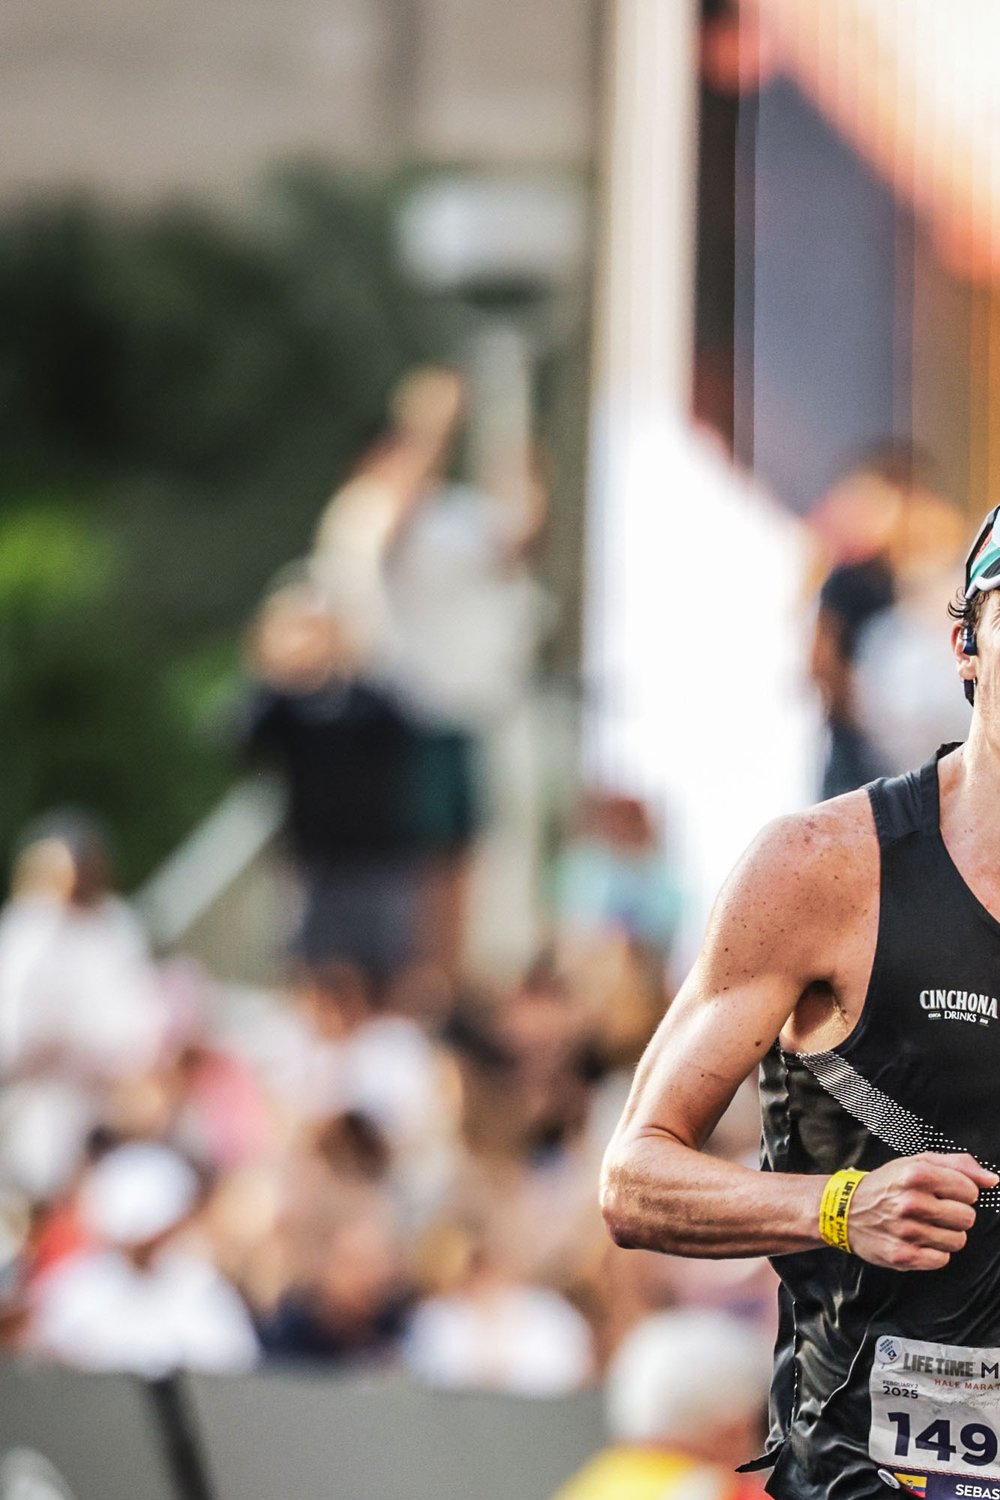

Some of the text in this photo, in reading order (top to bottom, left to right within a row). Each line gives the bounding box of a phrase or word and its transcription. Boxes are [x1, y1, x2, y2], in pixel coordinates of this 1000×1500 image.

[919, 989, 999, 1019] CINCHONA
[944, 1010, 977, 1023] DRINKS
[903, 1353, 934, 1374] LIFE
[935, 1358, 975, 1377] TIME
[882, 1386, 919, 1399] 2025
[955, 1484, 1000, 1500] SEBAS
